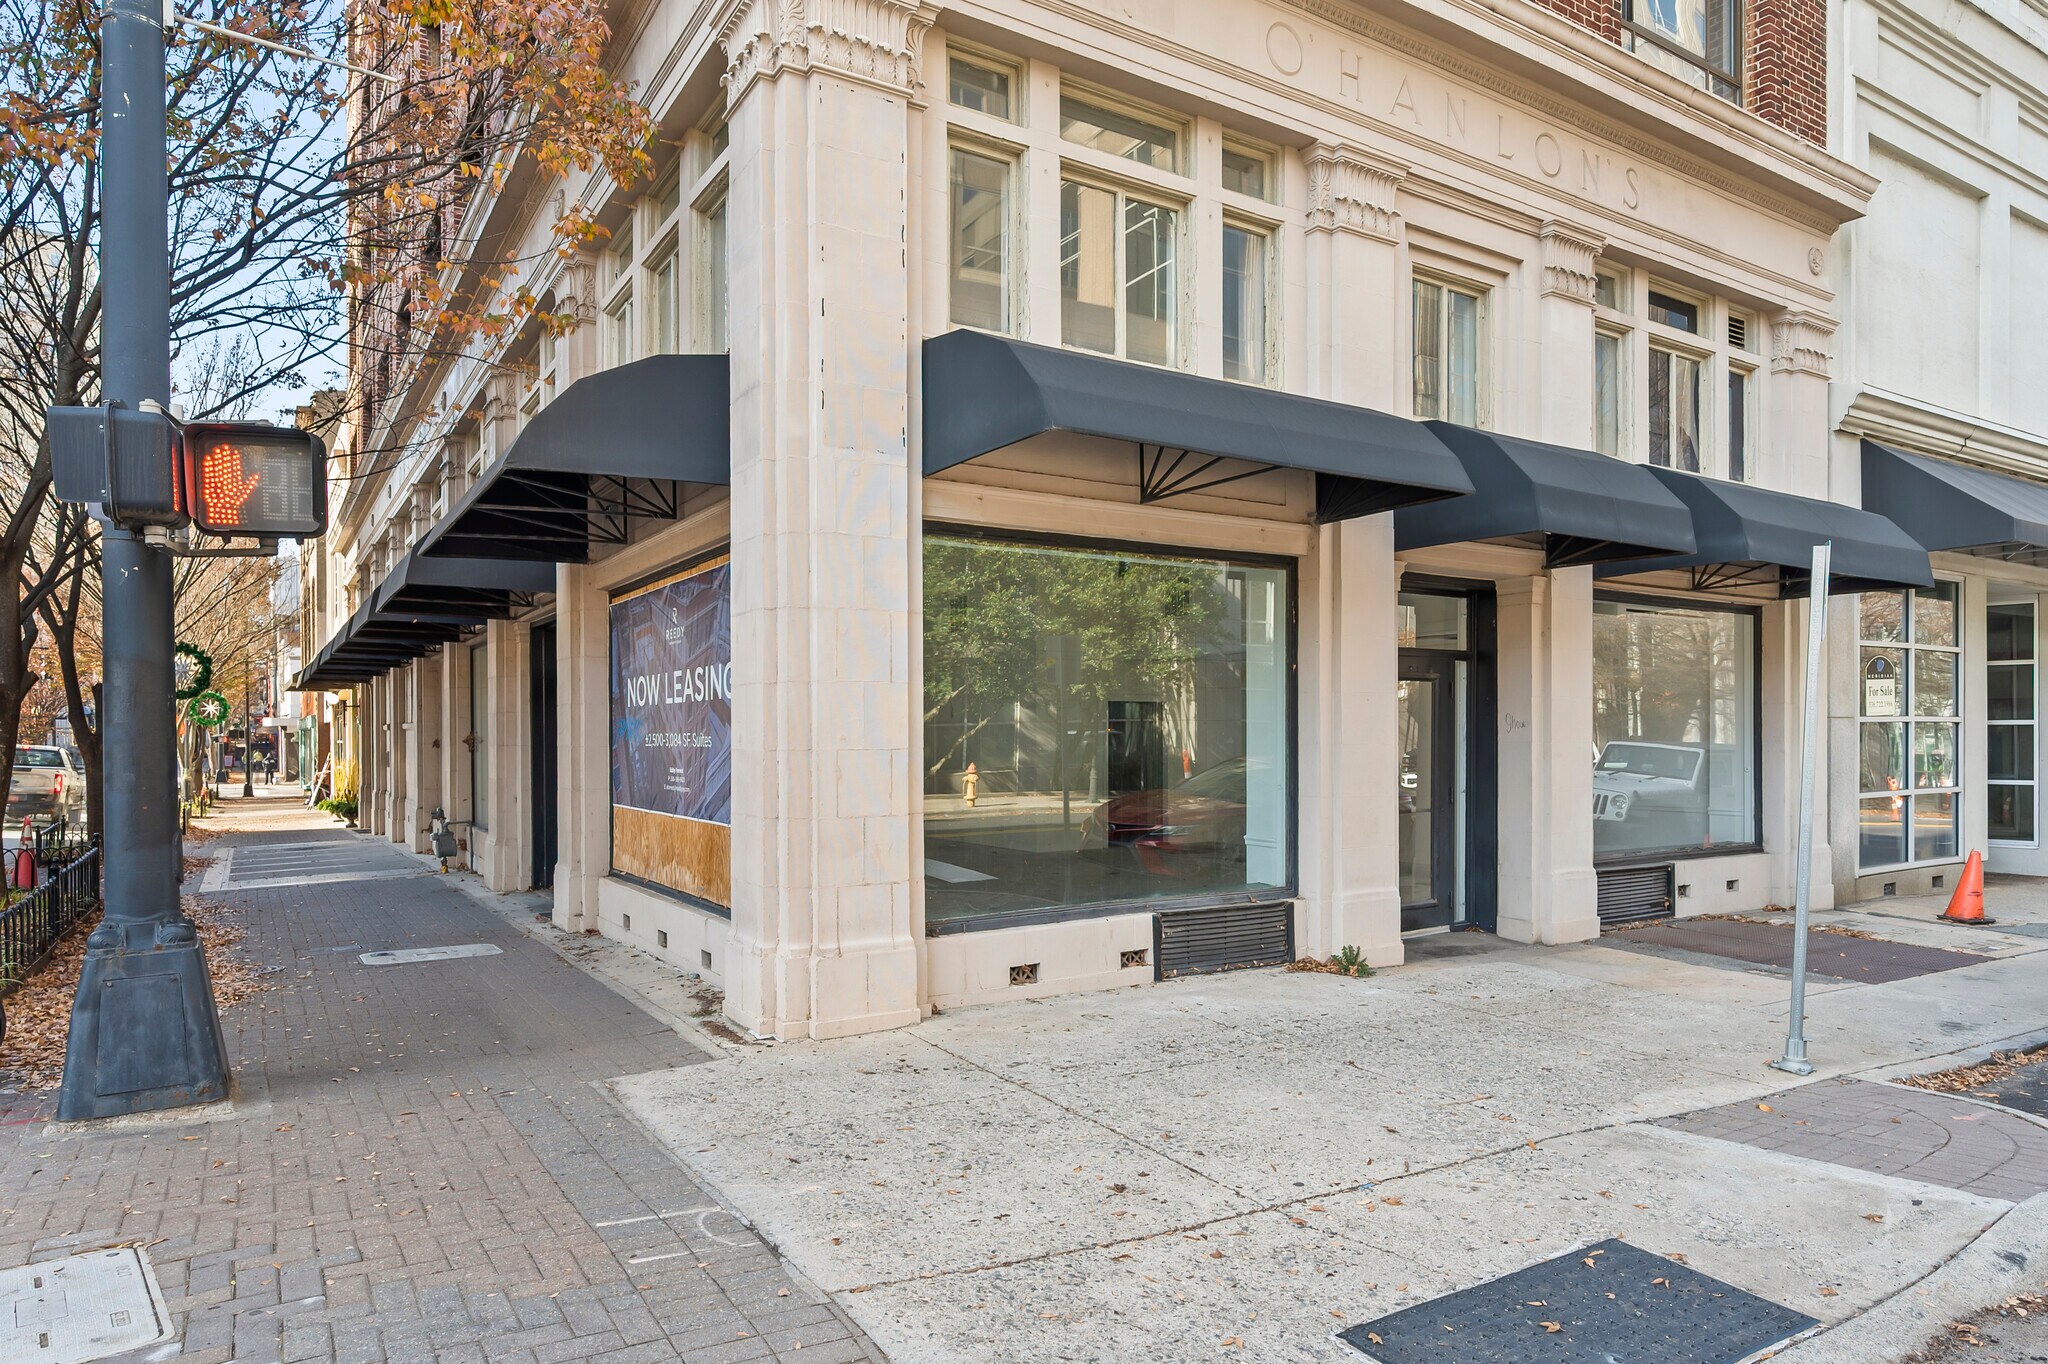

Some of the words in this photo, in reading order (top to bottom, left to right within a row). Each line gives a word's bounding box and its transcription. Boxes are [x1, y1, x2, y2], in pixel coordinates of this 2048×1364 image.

[665, 626, 685, 641] REEDY
[627, 673, 660, 707] NOW
[1868, 686, 1879, 696] For
[1880, 686, 1893, 696] Sale
[682, 732, 691, 748] SF
[692, 732, 712, 748] Suites
